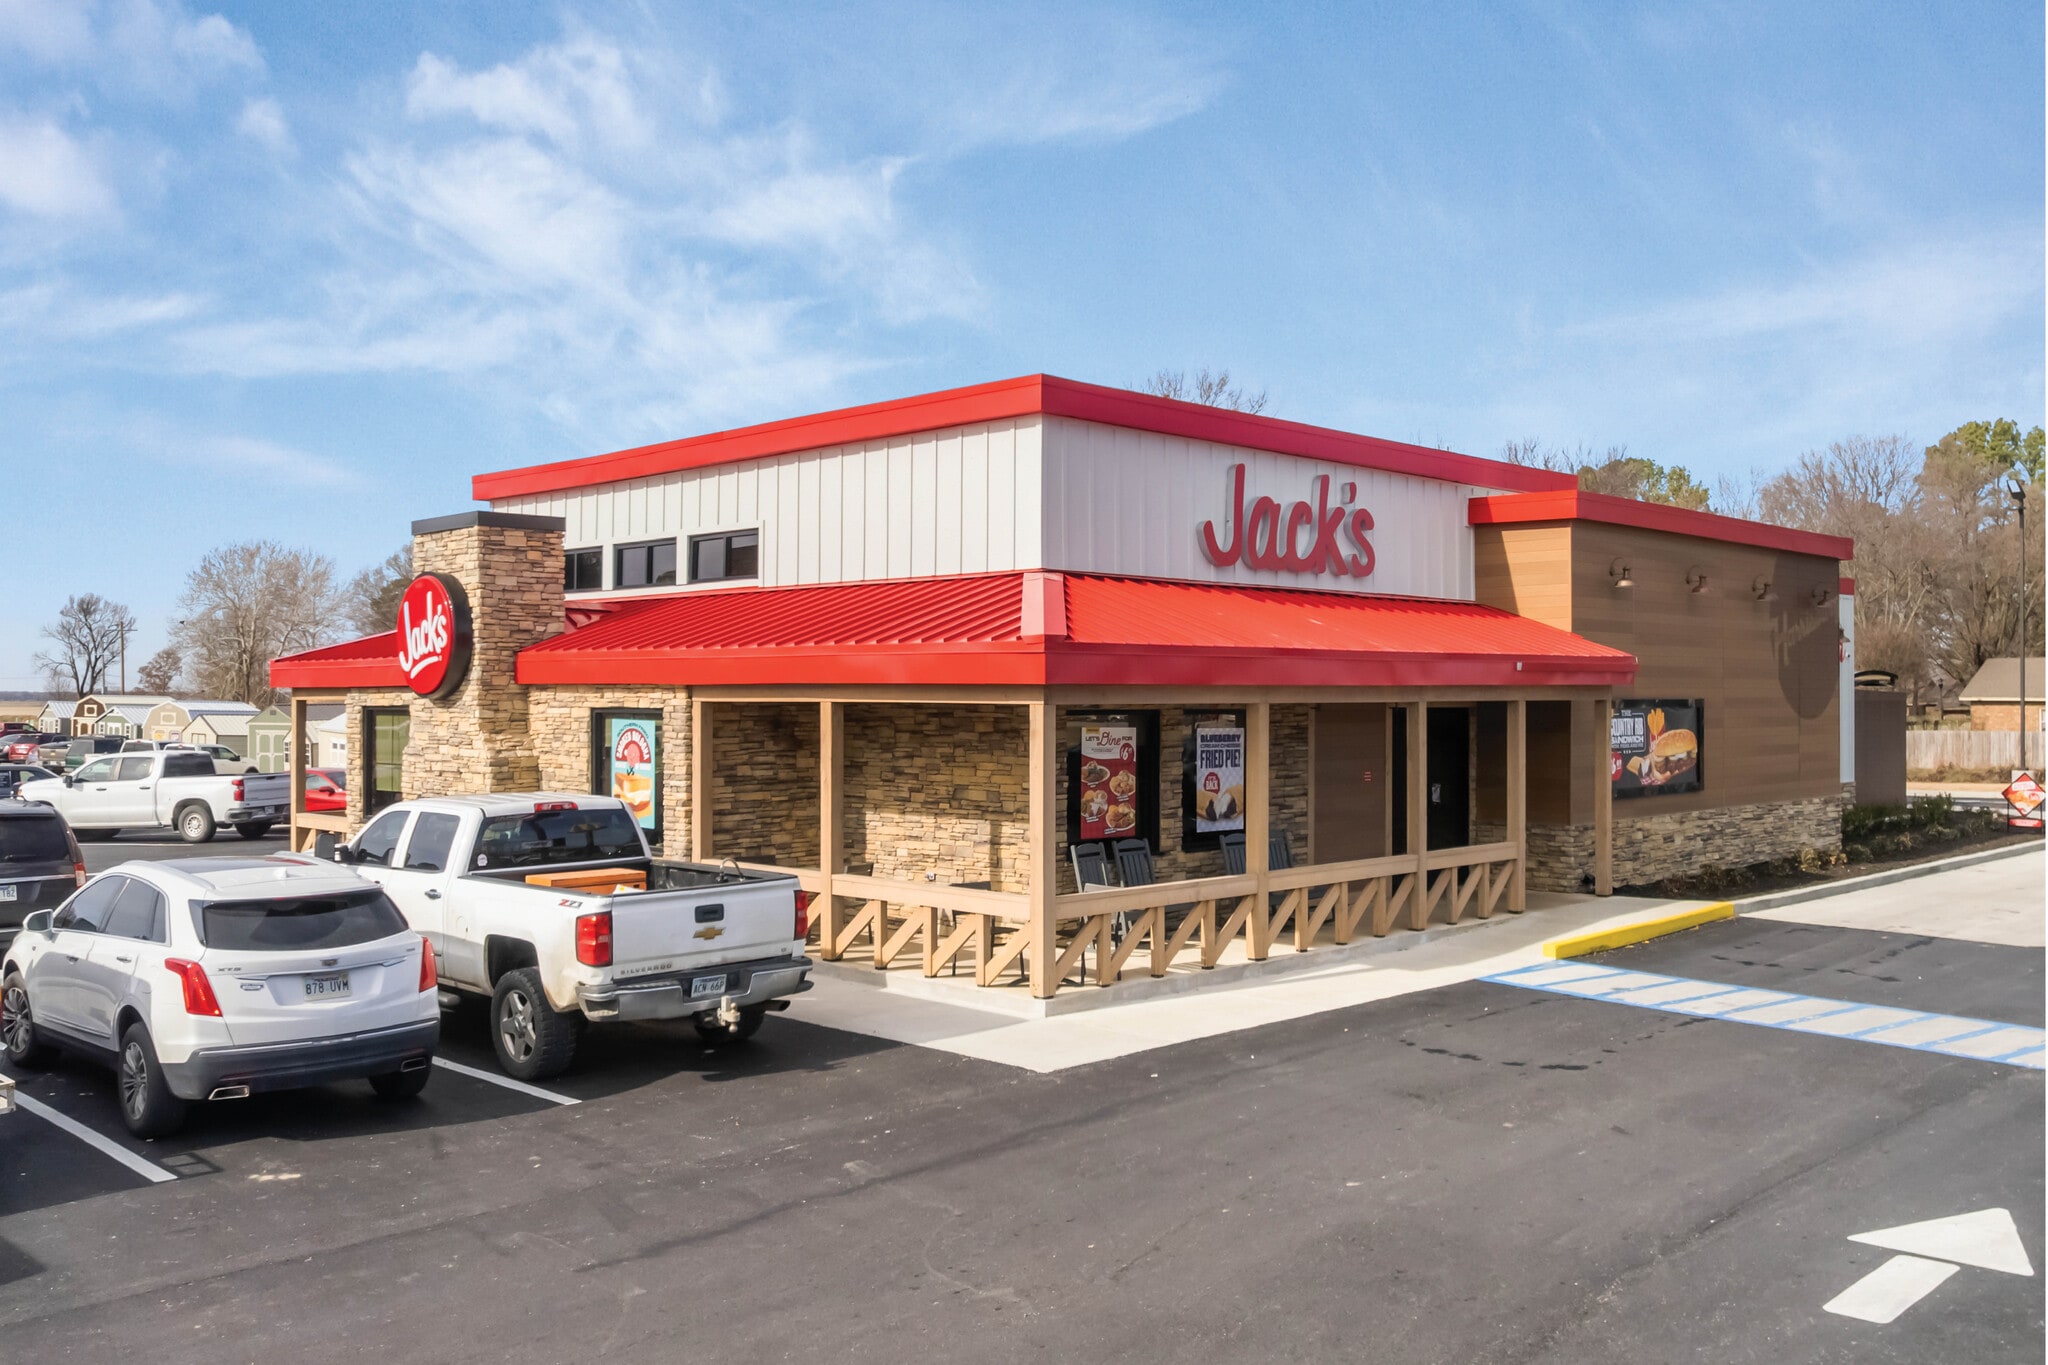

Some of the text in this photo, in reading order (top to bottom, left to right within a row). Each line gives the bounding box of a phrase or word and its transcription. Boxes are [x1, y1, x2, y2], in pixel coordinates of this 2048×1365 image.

[1197, 463, 1376, 577] Jack's
[399, 590, 448, 672] Jack's
[1200, 734, 1241, 743] BLUEBERRY
[1200, 749, 1224, 769] FRIED
[558, 899, 583, 908] Z71
[621, 963, 673, 976] SILVERADO
[305, 979, 349, 995] 878 UVM
